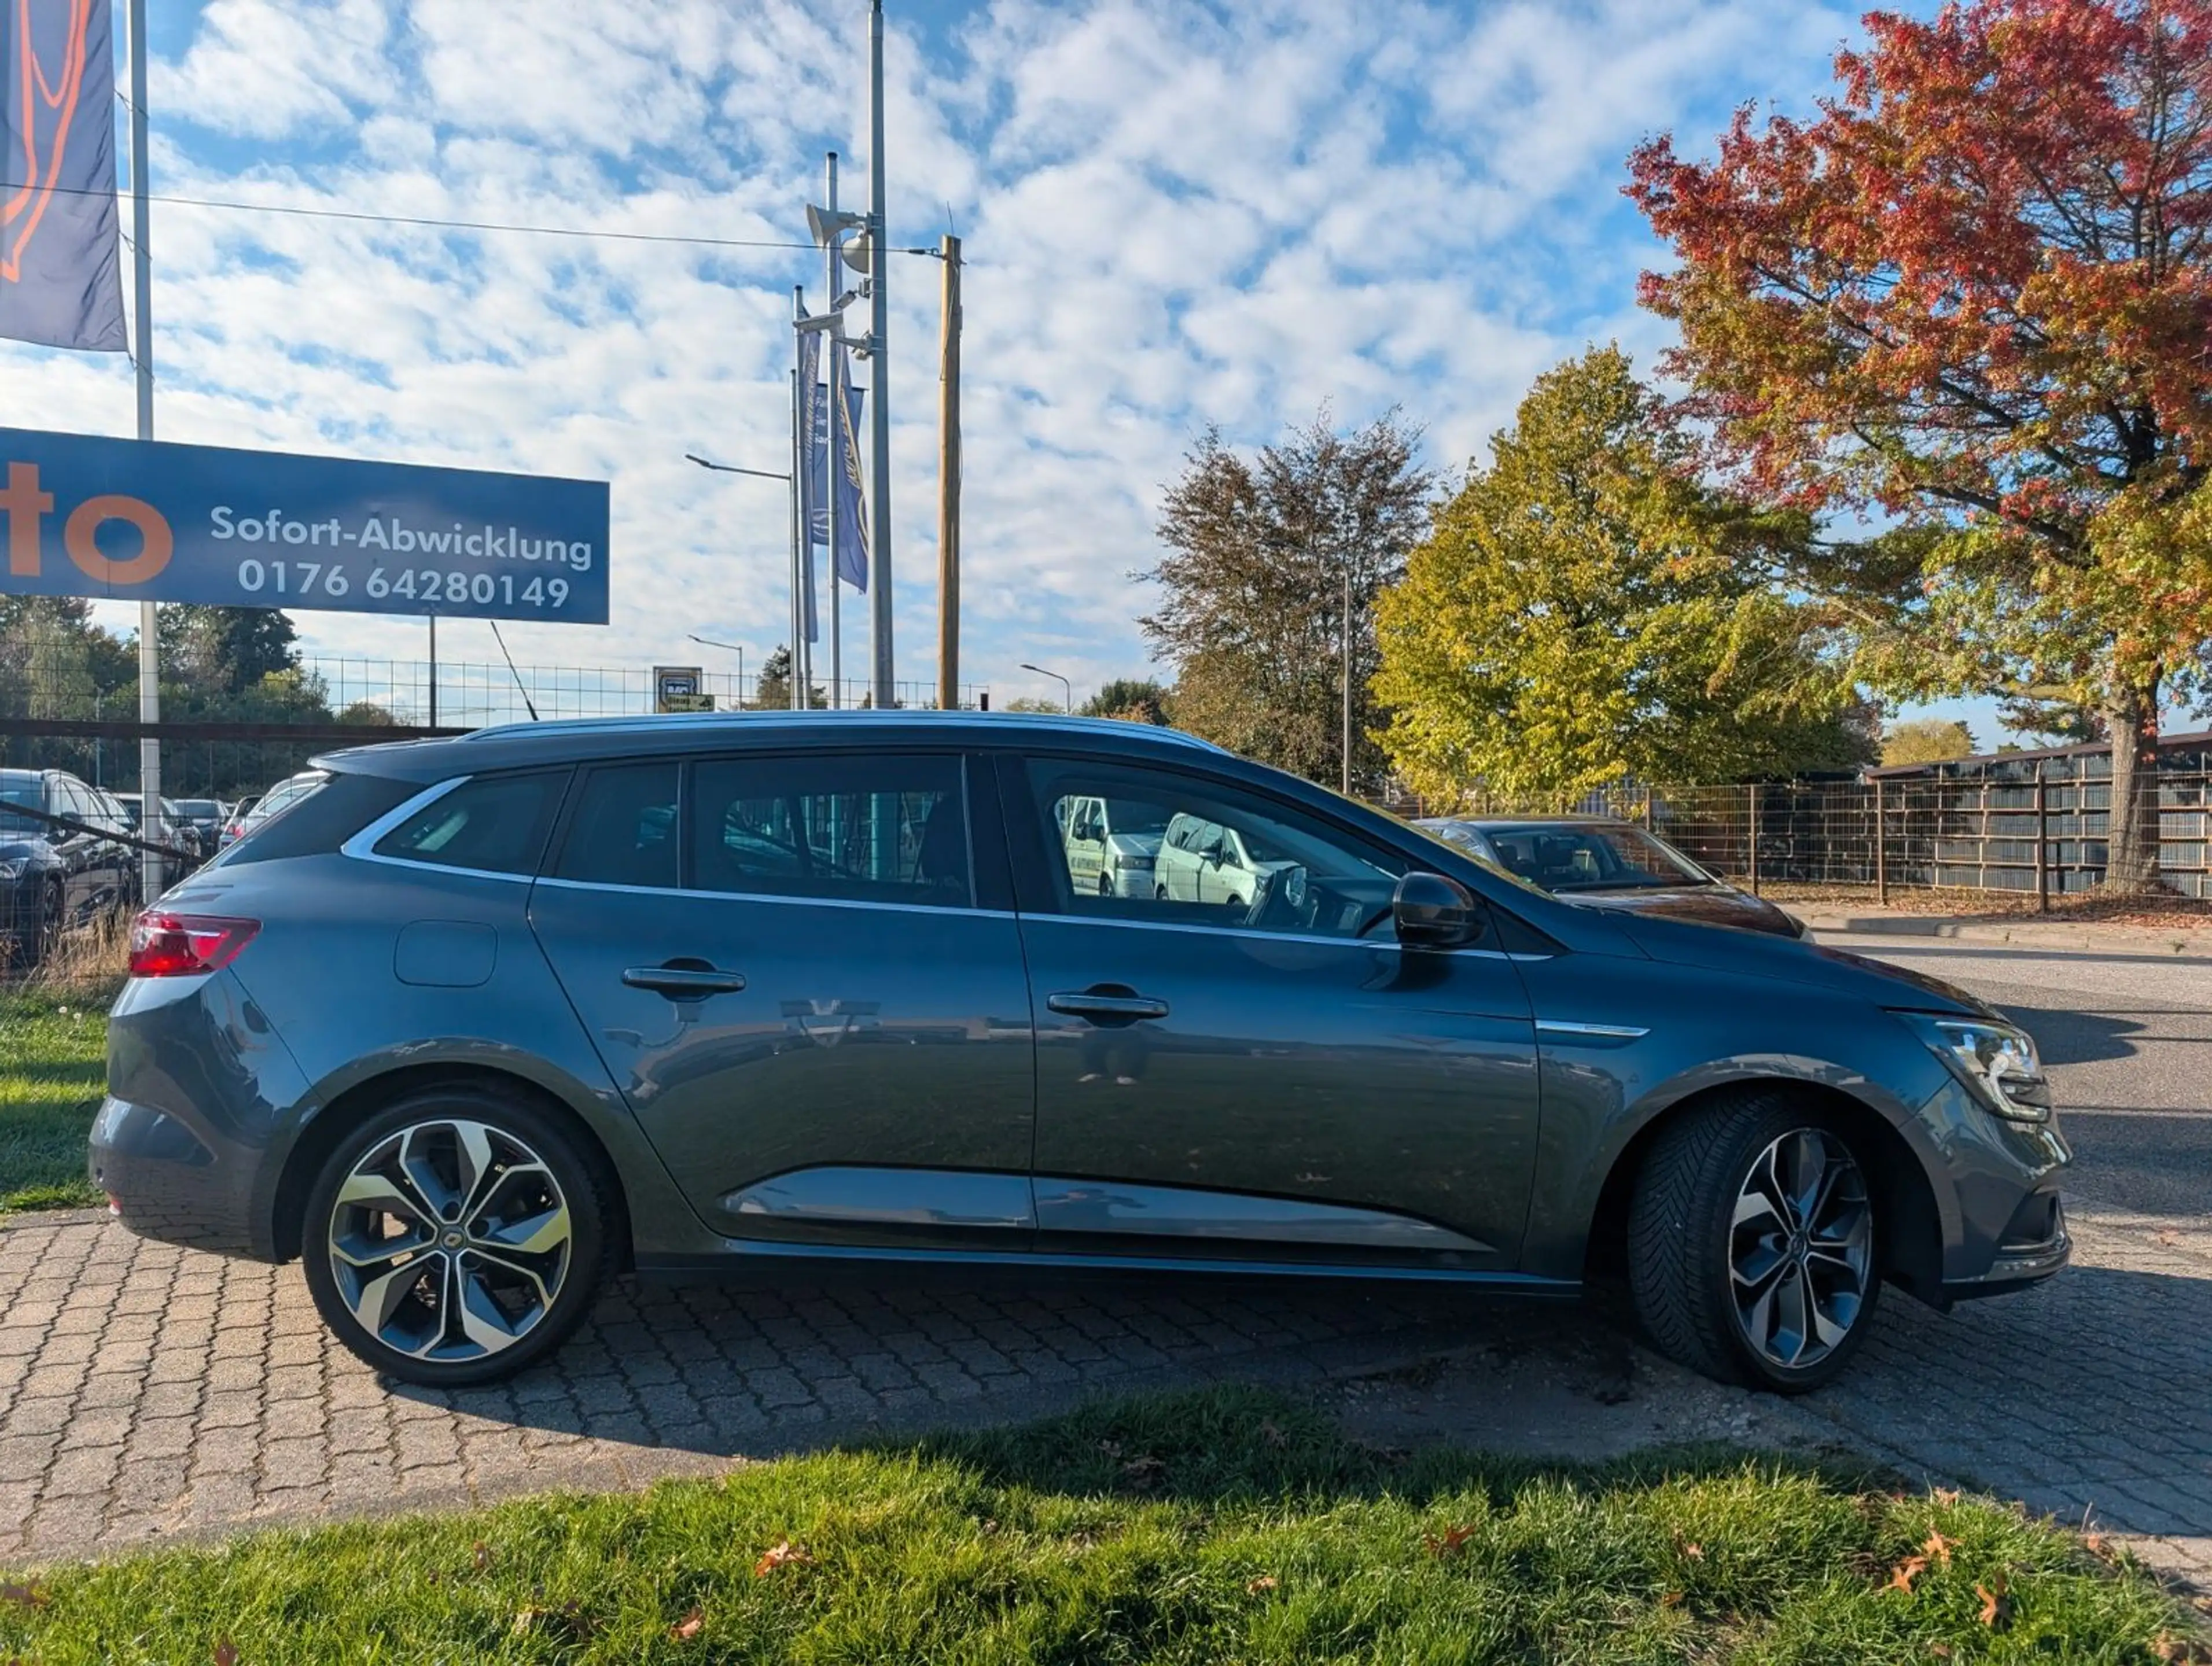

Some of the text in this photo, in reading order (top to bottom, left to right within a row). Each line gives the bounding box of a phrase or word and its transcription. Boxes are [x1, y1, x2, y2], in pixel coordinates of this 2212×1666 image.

[0, 461, 173, 585] to
[210, 506, 591, 572] Sofort-Abwicklung
[238, 559, 569, 607] 0176 64280149
